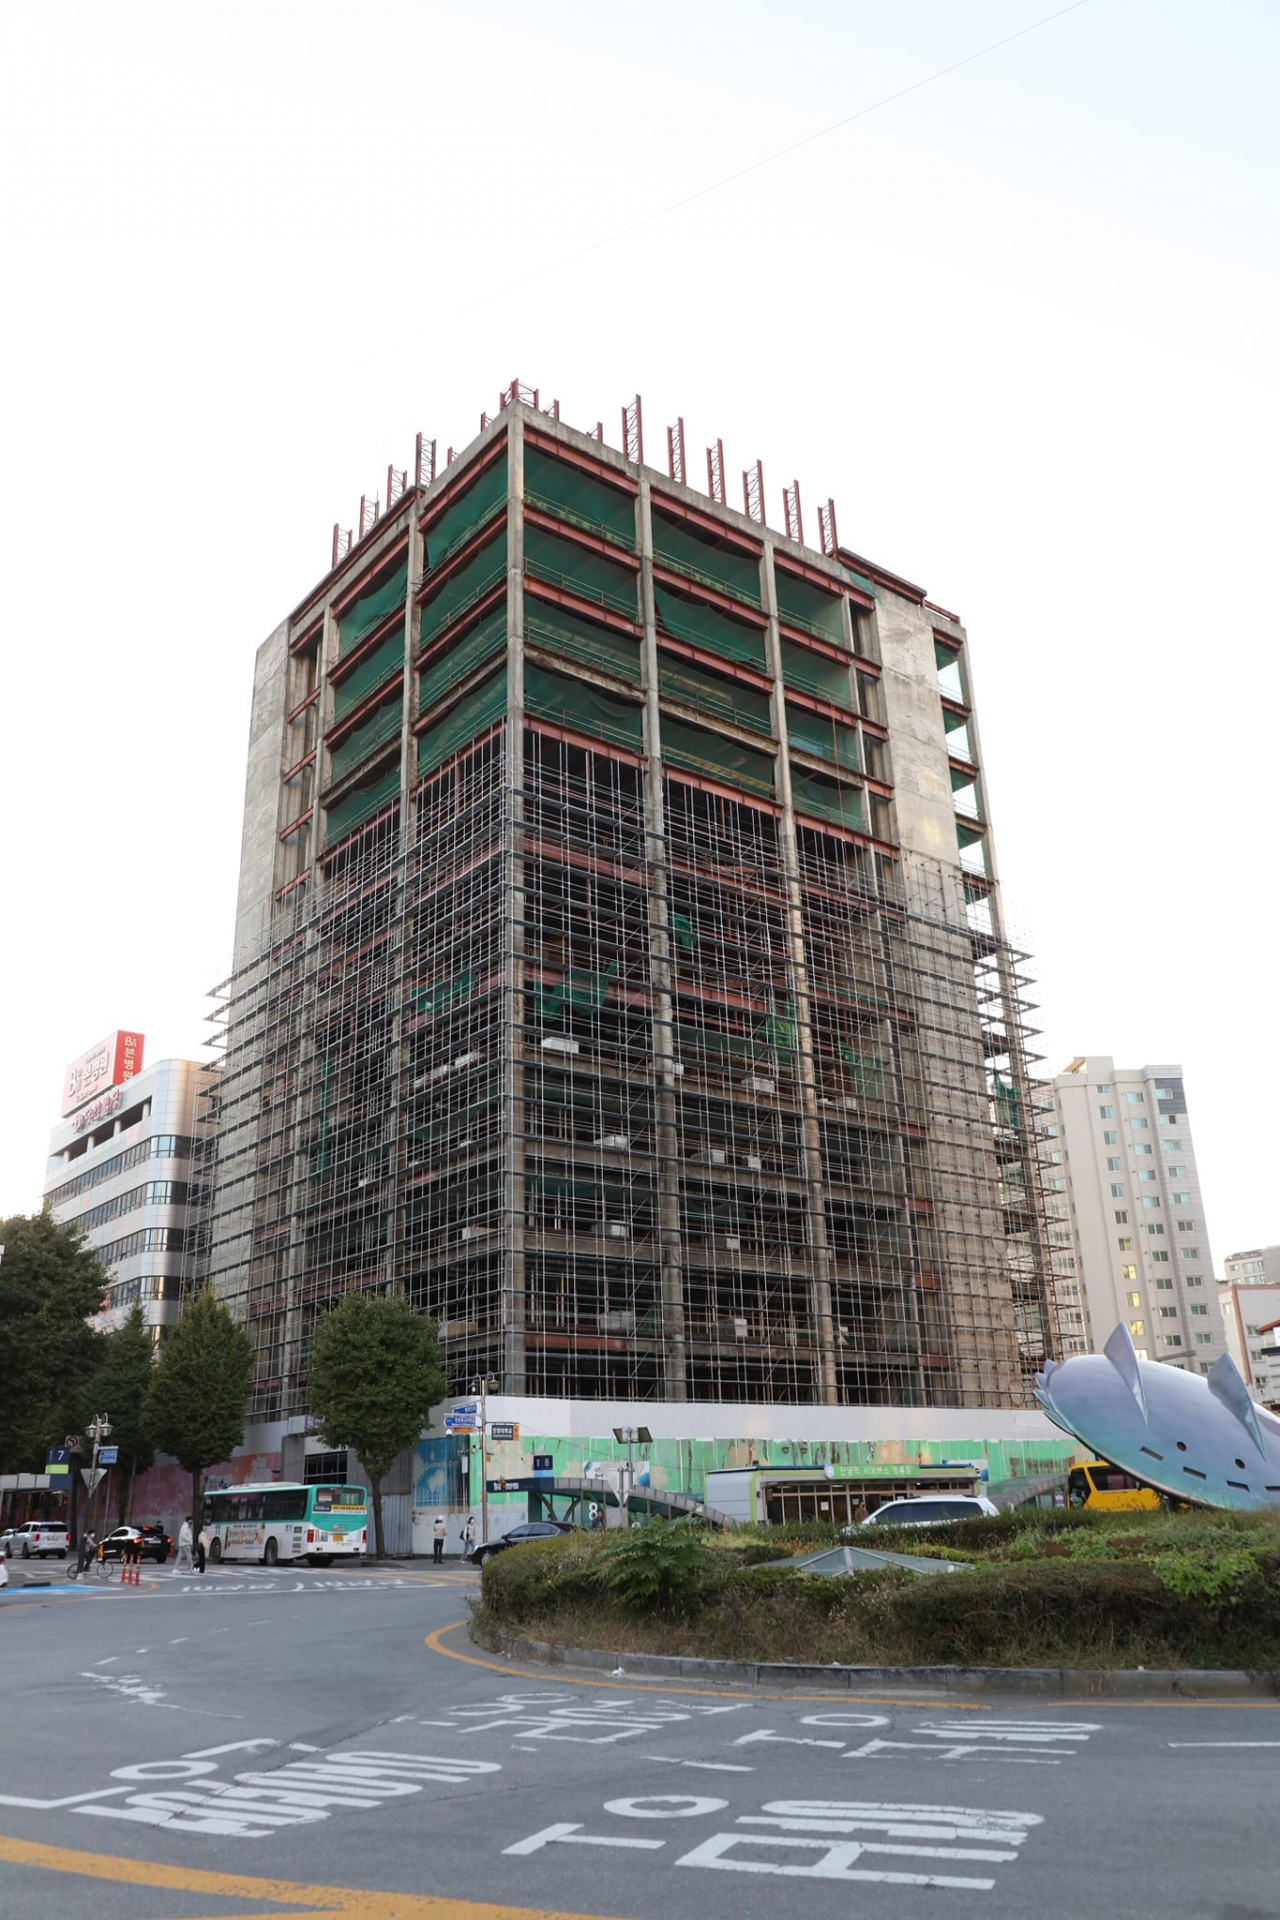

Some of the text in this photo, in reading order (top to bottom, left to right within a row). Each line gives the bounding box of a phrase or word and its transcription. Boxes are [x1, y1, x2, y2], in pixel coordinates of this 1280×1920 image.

[58, 1450, 65, 1461] 7
[544, 1458, 550, 1467] 8
[863, 1465, 889, 1476] 시외버스
[893, 1465, 912, 1476] 정류장
[589, 1502, 598, 1521] 8
[730, 1712, 1105, 1765] 양보
[501, 1795, 1045, 1890] 양보
